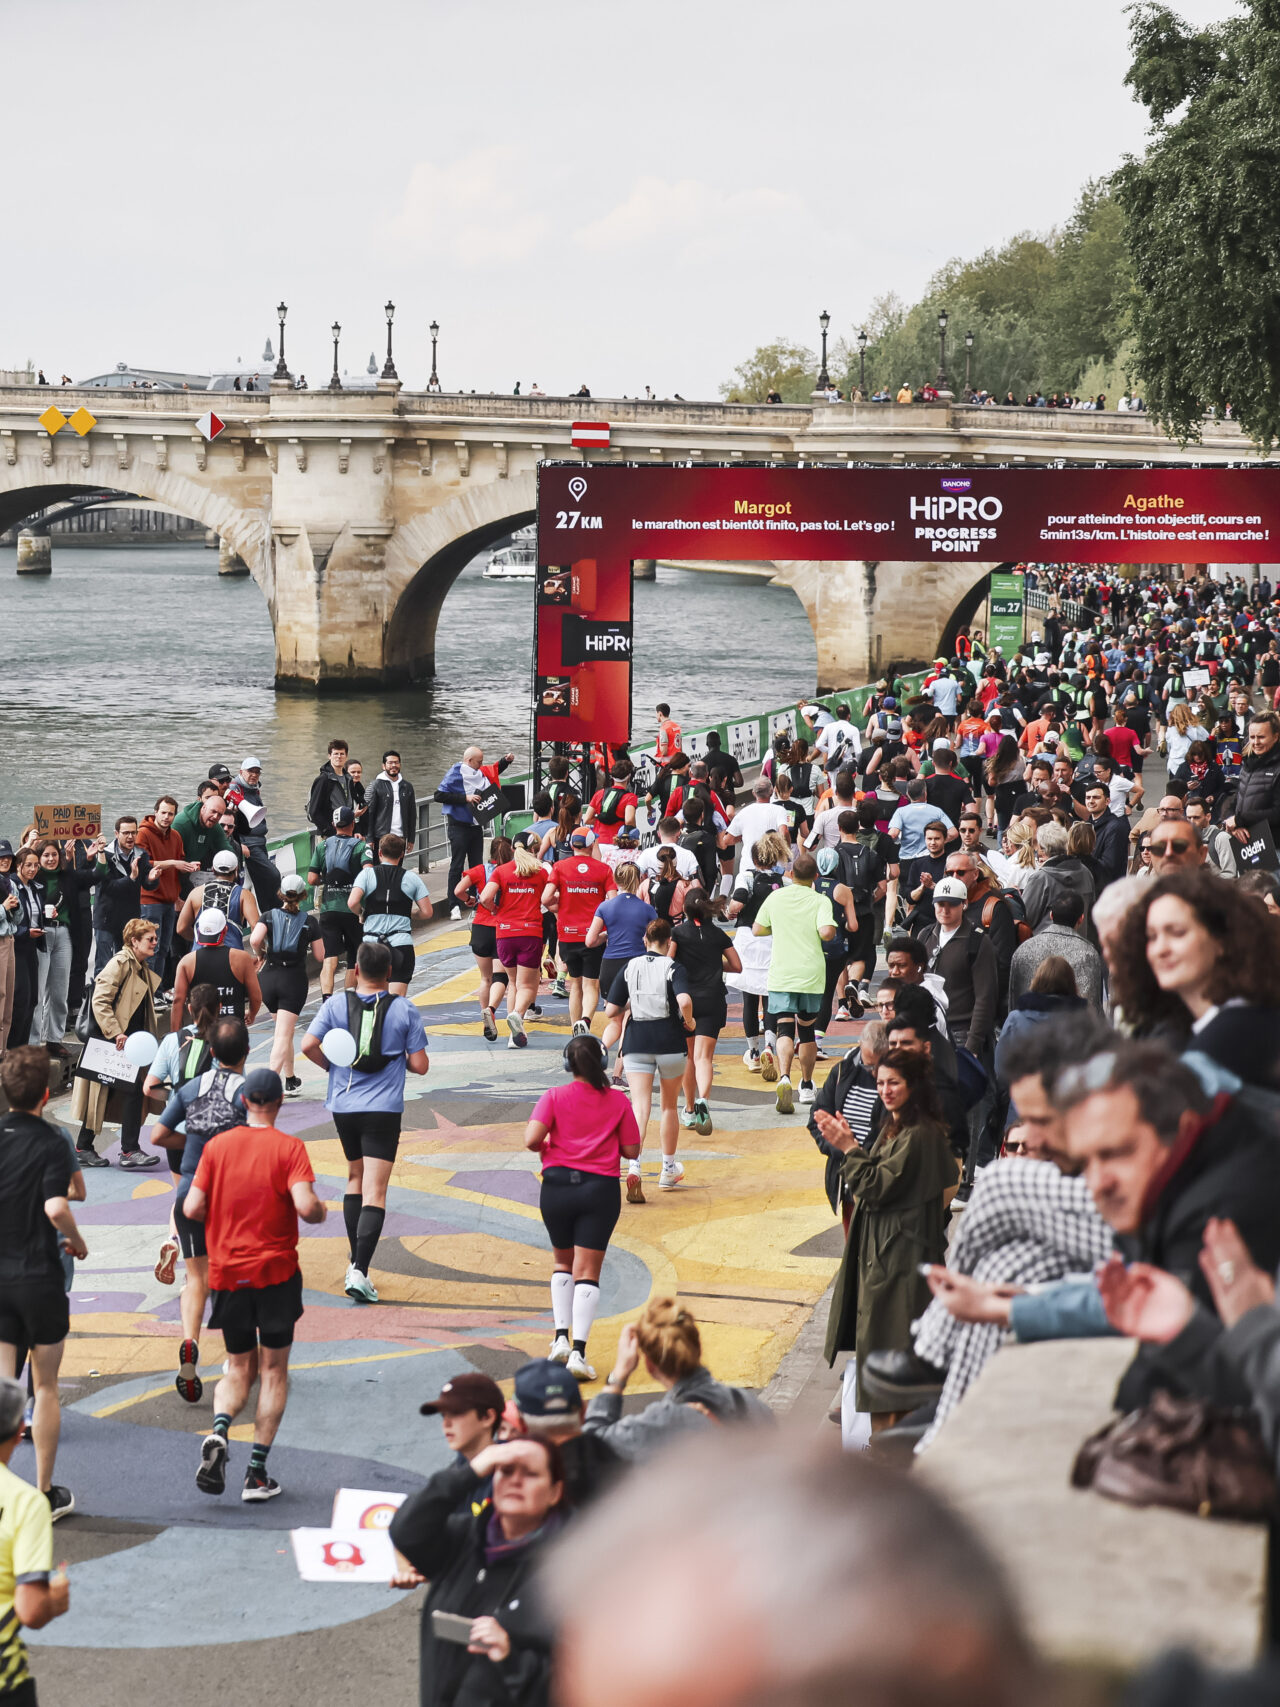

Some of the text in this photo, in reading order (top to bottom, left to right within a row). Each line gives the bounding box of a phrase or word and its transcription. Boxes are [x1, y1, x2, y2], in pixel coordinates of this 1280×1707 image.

[942, 480, 971, 488] DANONE
[910, 496, 1003, 520] HiPRO
[1123, 494, 1184, 510] Agathe
[734, 500, 792, 518] Margot
[632, 520, 644, 530] le
[644, 520, 701, 530] marathon
[702, 520, 721, 530] est
[722, 519, 764, 531] bientôt
[766, 519, 799, 532] finito,
[800, 522, 822, 534] pas
[823, 520, 842, 531] toi.
[844, 520, 873, 532] Let's
[874, 522, 890, 534] go
[1047, 514, 1262, 527] pour atteindre ton objectif, cours en
[915, 528, 997, 540] PROGRESS
[1040, 530, 1118, 542] 5min13s/km.
[1120, 529, 1176, 541] L'histoire
[1177, 530, 1197, 541] est
[1198, 532, 1216, 541] en
[1216, 529, 1263, 541] marche
[931, 540, 979, 552] POINT
[1008, 602, 1020, 612] 27
